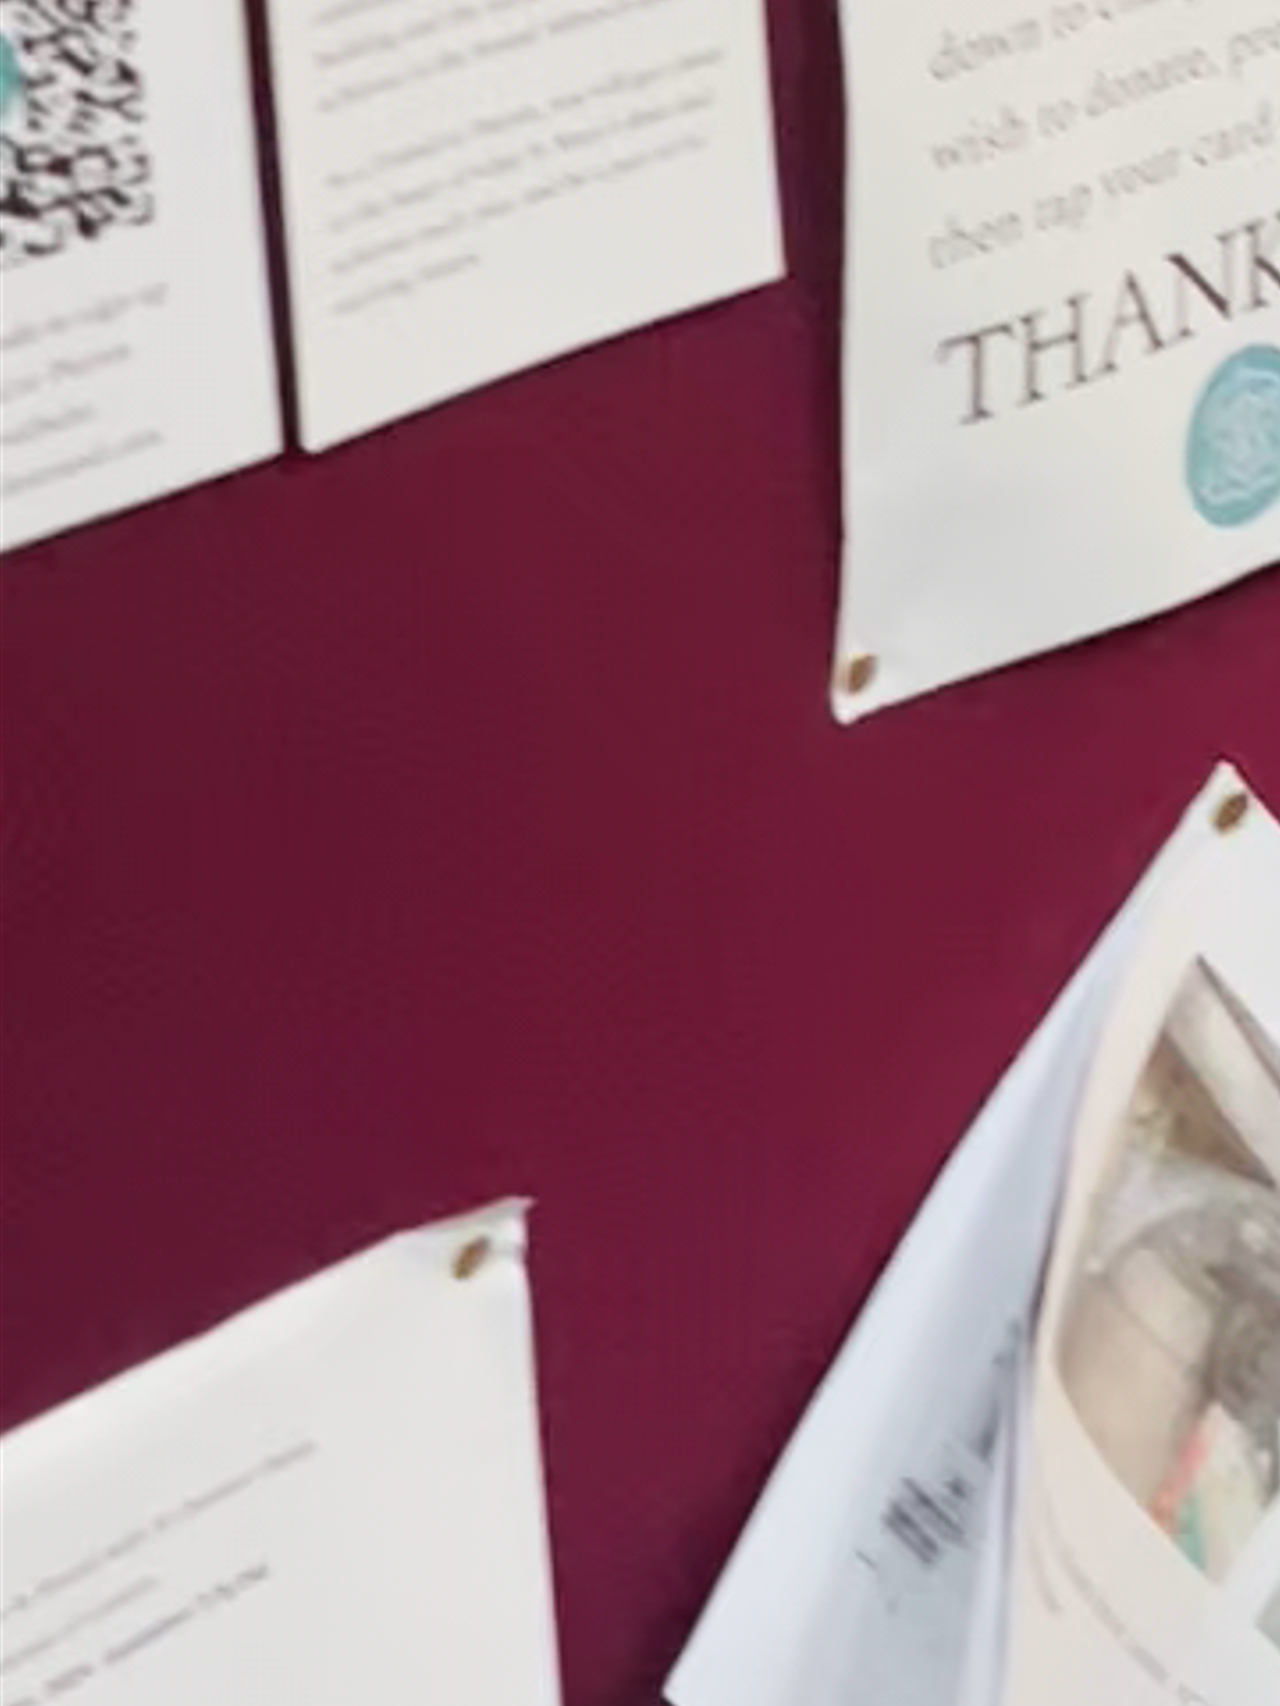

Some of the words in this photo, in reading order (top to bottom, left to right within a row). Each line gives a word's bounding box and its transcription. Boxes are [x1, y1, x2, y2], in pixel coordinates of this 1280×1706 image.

[929, 17, 1042, 82] down
[1049, 0, 1090, 39] to
[930, 104, 1030, 170] wish
[1036, 100, 1079, 139] to
[926, 210, 1024, 270] then
[1033, 182, 1094, 232] tap
[1099, 147, 1182, 210] your
[1193, 97, 1275, 167] card
